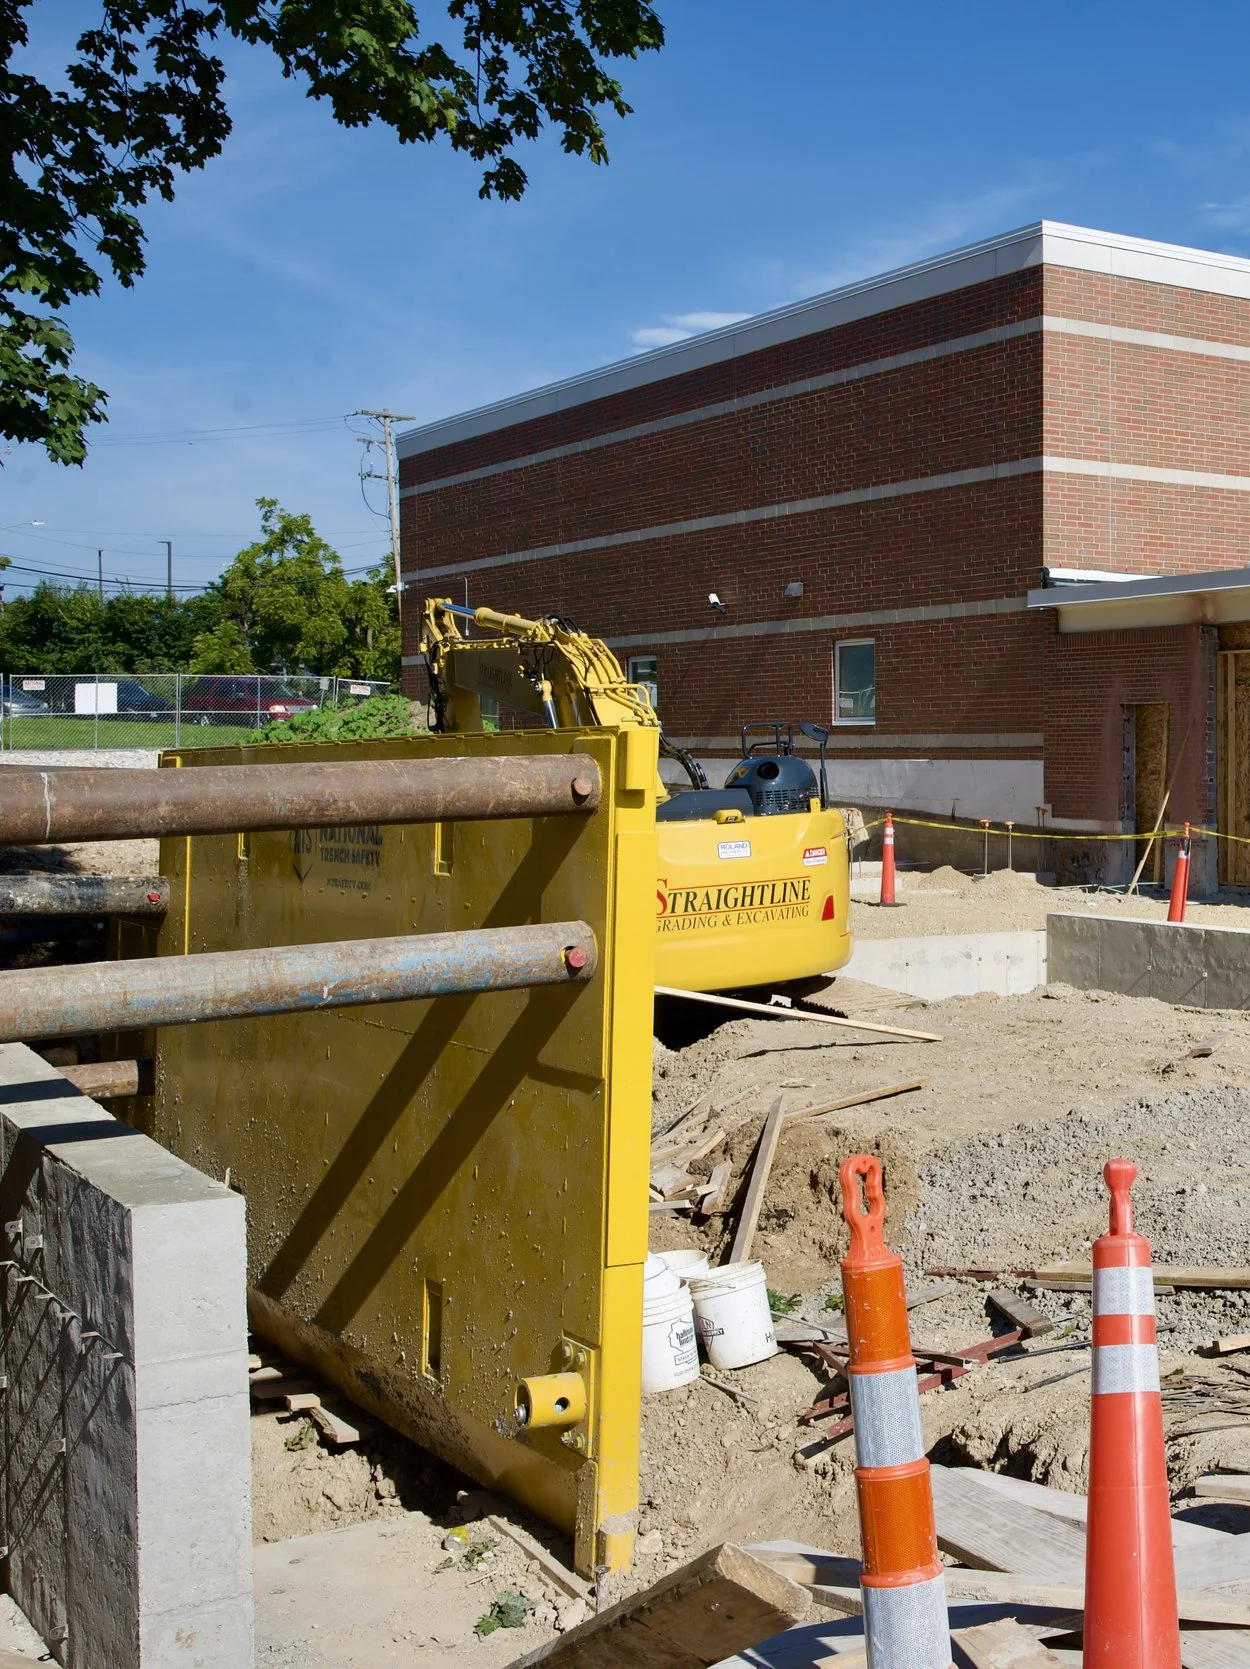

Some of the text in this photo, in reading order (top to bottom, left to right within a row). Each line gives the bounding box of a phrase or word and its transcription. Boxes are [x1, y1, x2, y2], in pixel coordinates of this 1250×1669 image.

[320, 826, 382, 846] NATIONAL
[321, 847, 380, 867] TRENCH SAFETY
[656, 878, 811, 915] STRAIGHTLINE
[722, 914, 731, 926] &
[737, 904, 809, 925] EXCAVATING
